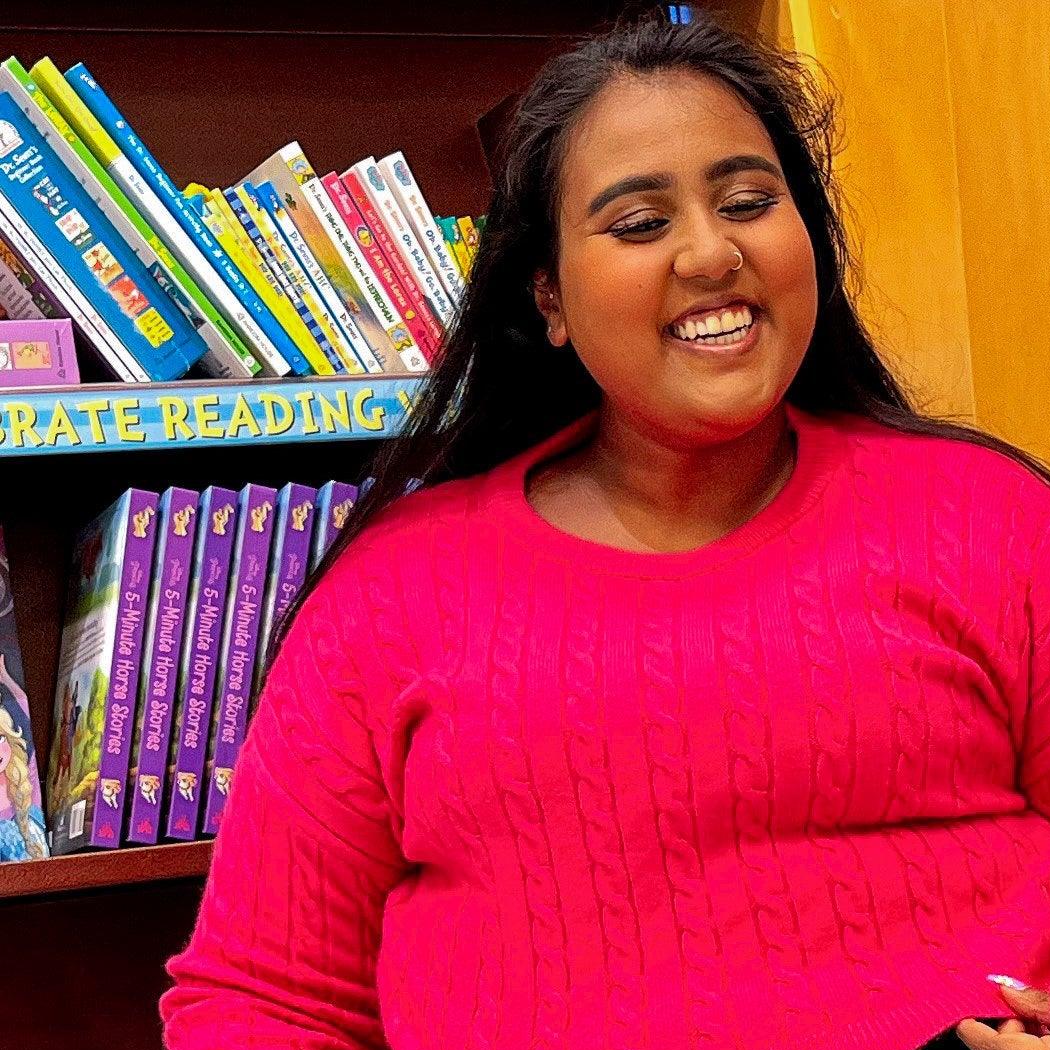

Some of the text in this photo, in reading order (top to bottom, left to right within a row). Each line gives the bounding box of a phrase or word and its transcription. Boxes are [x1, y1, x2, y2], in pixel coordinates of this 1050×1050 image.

[389, 283, 407, 307] Lorax
[158, 389, 386, 441] READING
[119, 592, 141, 655] 5-Minute
[159, 588, 180, 652] 5-Minute
[197, 587, 219, 650] 5-Minute
[235, 584, 257, 648] 5-Minute
[114, 659, 134, 700] Horse
[153, 656, 174, 696] Horse
[191, 653, 212, 694] Horse
[229, 650, 250, 692] Horse
[108, 703, 130, 755] Stories
[146, 700, 168, 752] Stories
[184, 697, 206, 749] Stories
[222, 694, 244, 744] Stories
